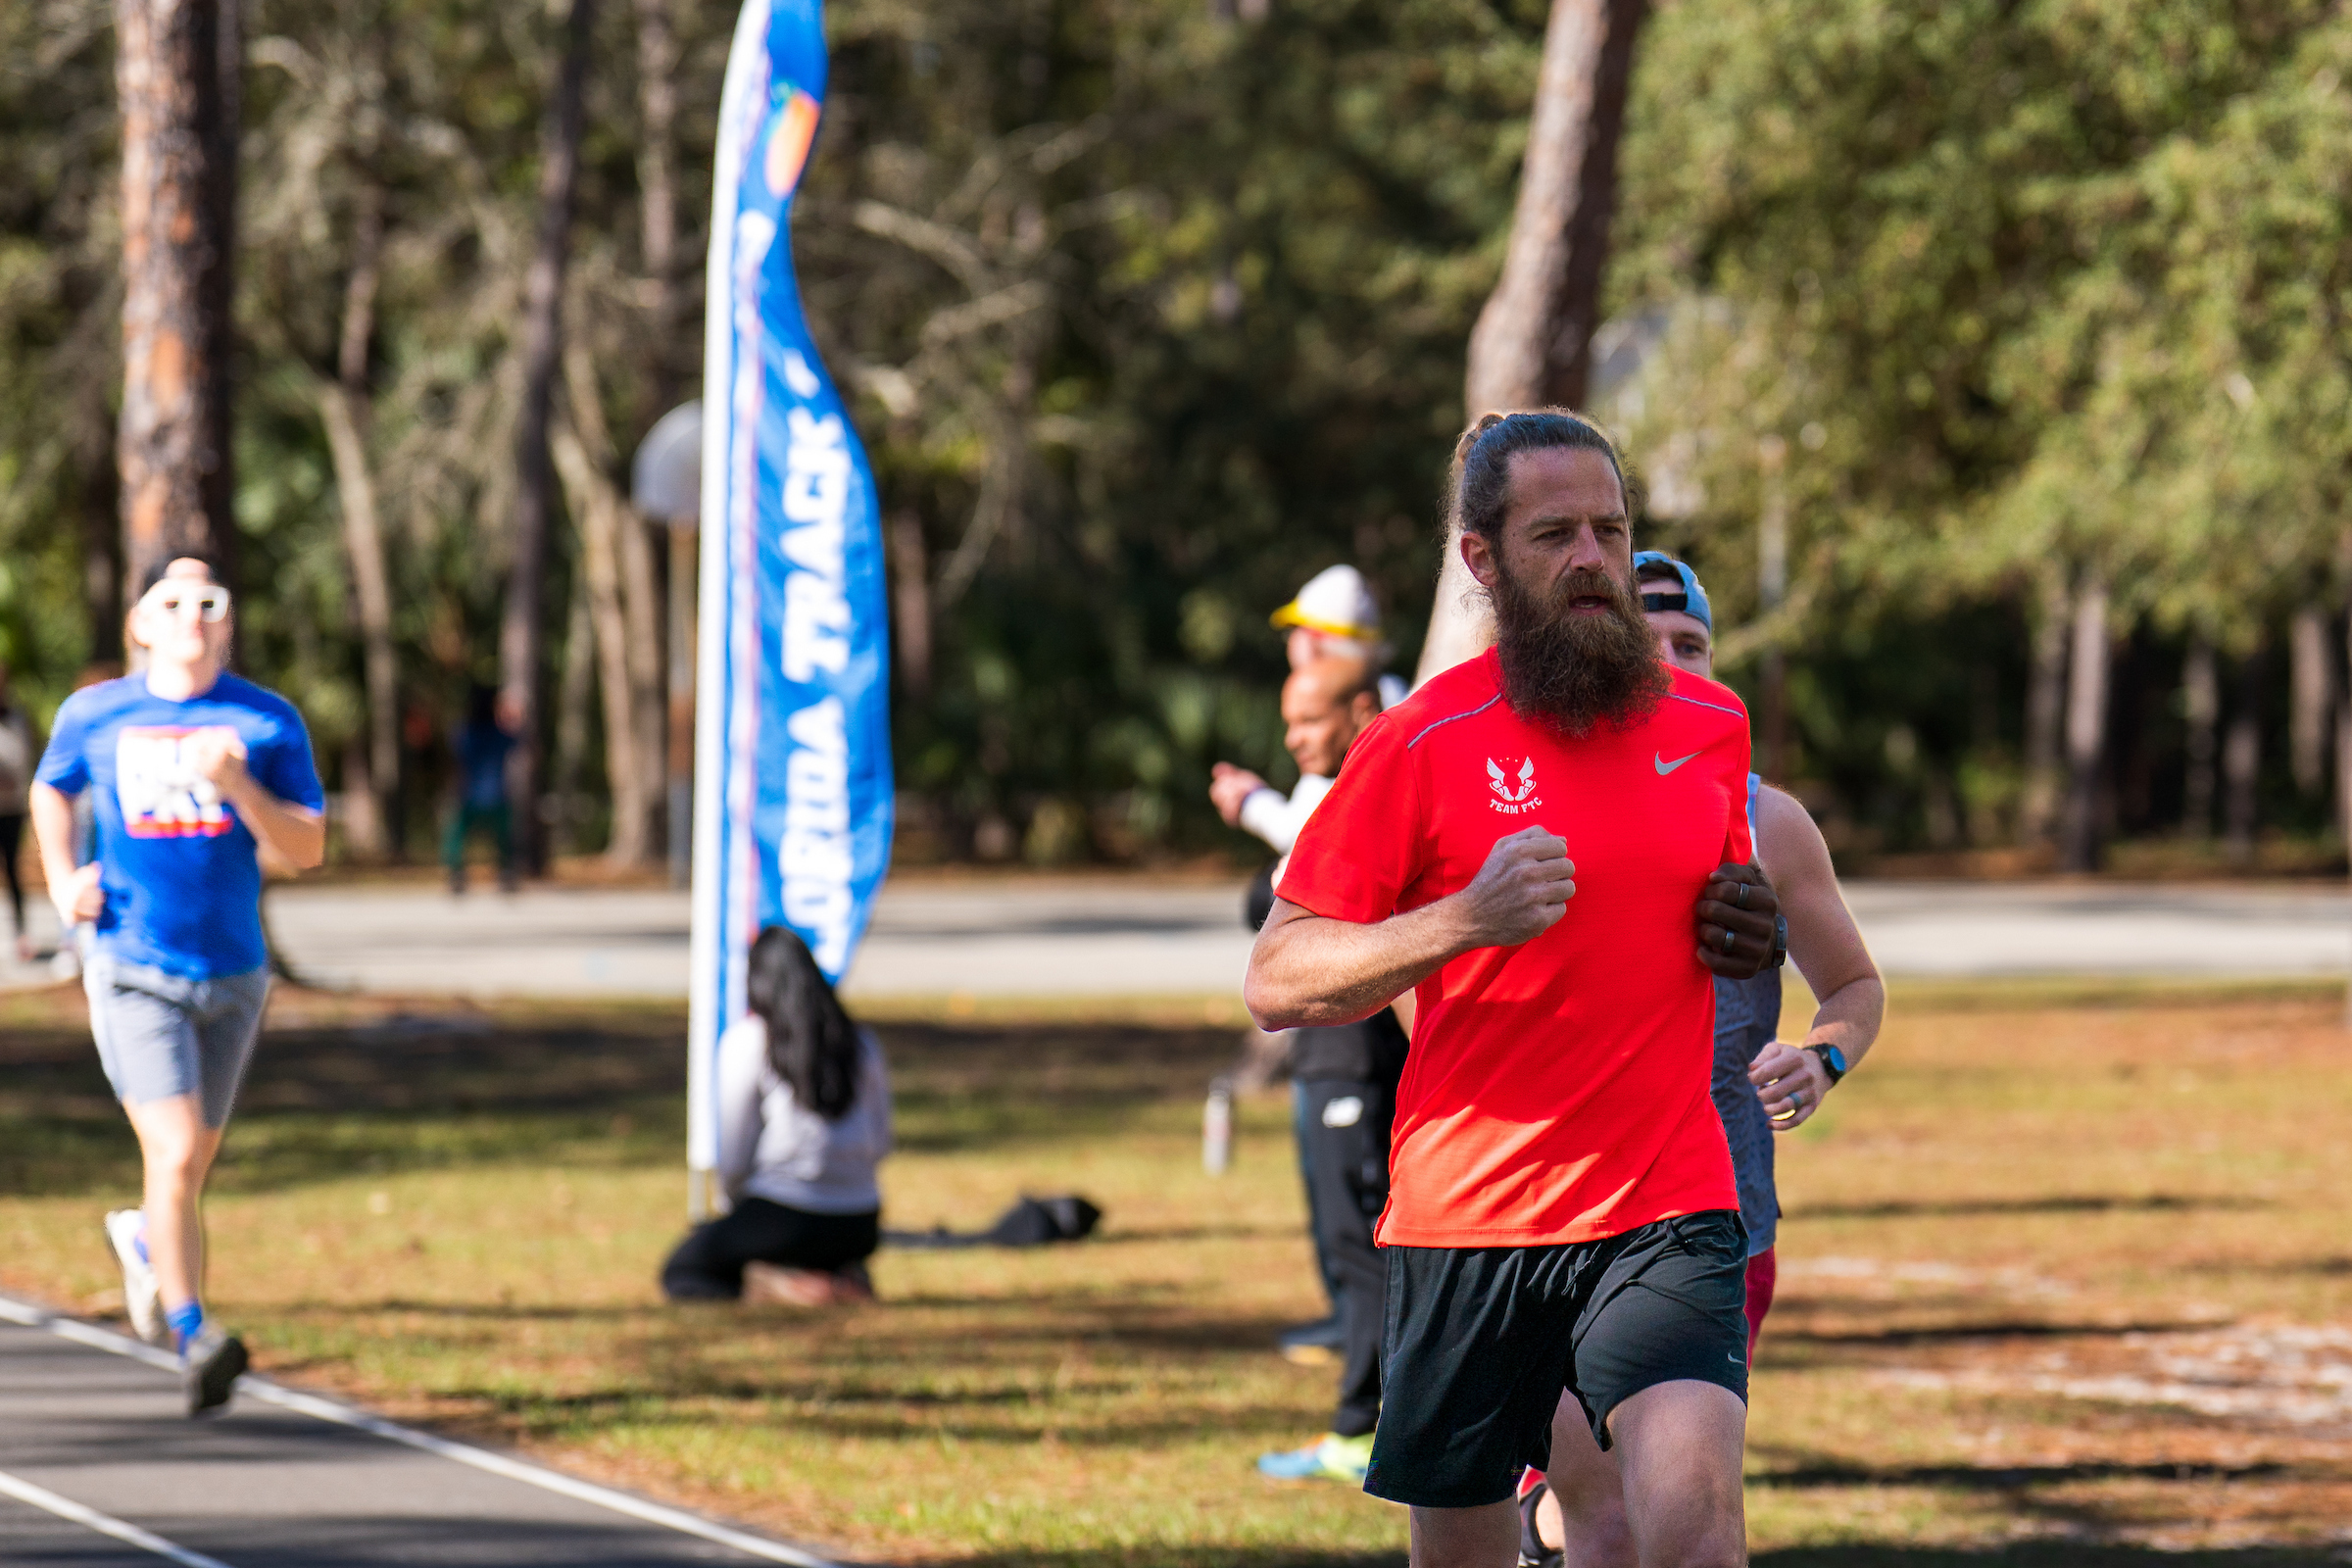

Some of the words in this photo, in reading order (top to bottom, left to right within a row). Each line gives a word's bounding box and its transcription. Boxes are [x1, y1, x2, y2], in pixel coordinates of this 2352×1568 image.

[780, 406, 851, 684] TRACK
[1489, 798, 1519, 814] TEAM
[1520, 796, 1543, 813] FTC
